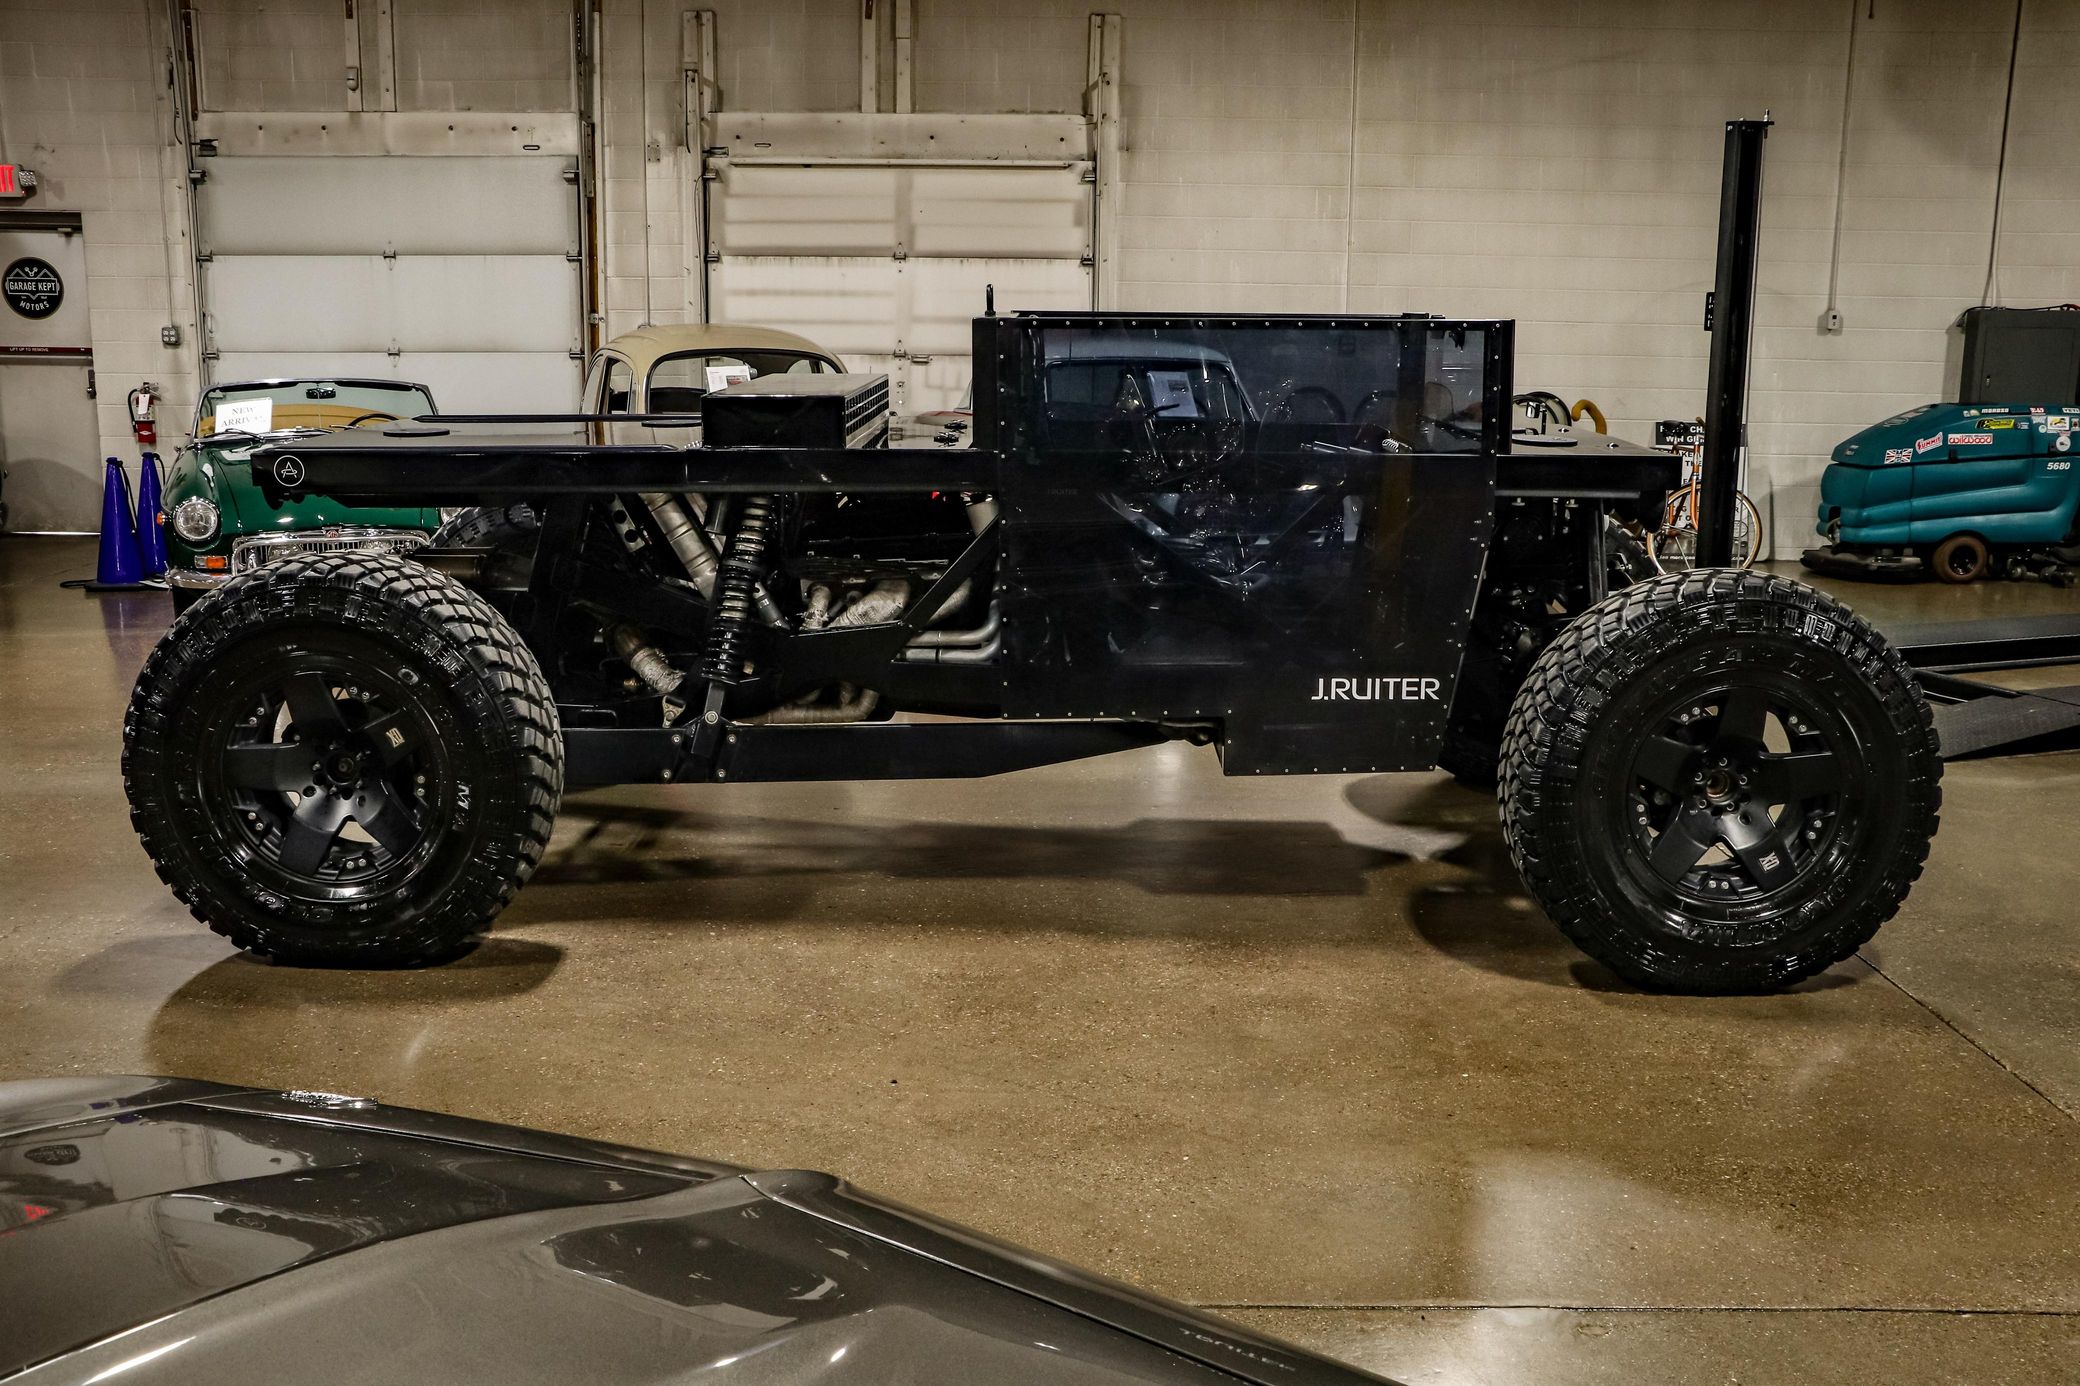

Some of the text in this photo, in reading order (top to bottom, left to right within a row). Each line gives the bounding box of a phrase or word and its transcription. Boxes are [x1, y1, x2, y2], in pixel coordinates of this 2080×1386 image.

[9, 281, 56, 291] GARAGE KEPT
[19, 300, 50, 311] MOTORS
[232, 406, 256, 415] NEW
[220, 415, 266, 428] ARRIV
[1690, 425, 1704, 433] CH
[1917, 436, 1941, 450] SUMMIT
[1949, 434, 1992, 444] wilwood
[2046, 462, 2071, 470] 5680
[1311, 678, 1441, 700] J.RUITER
